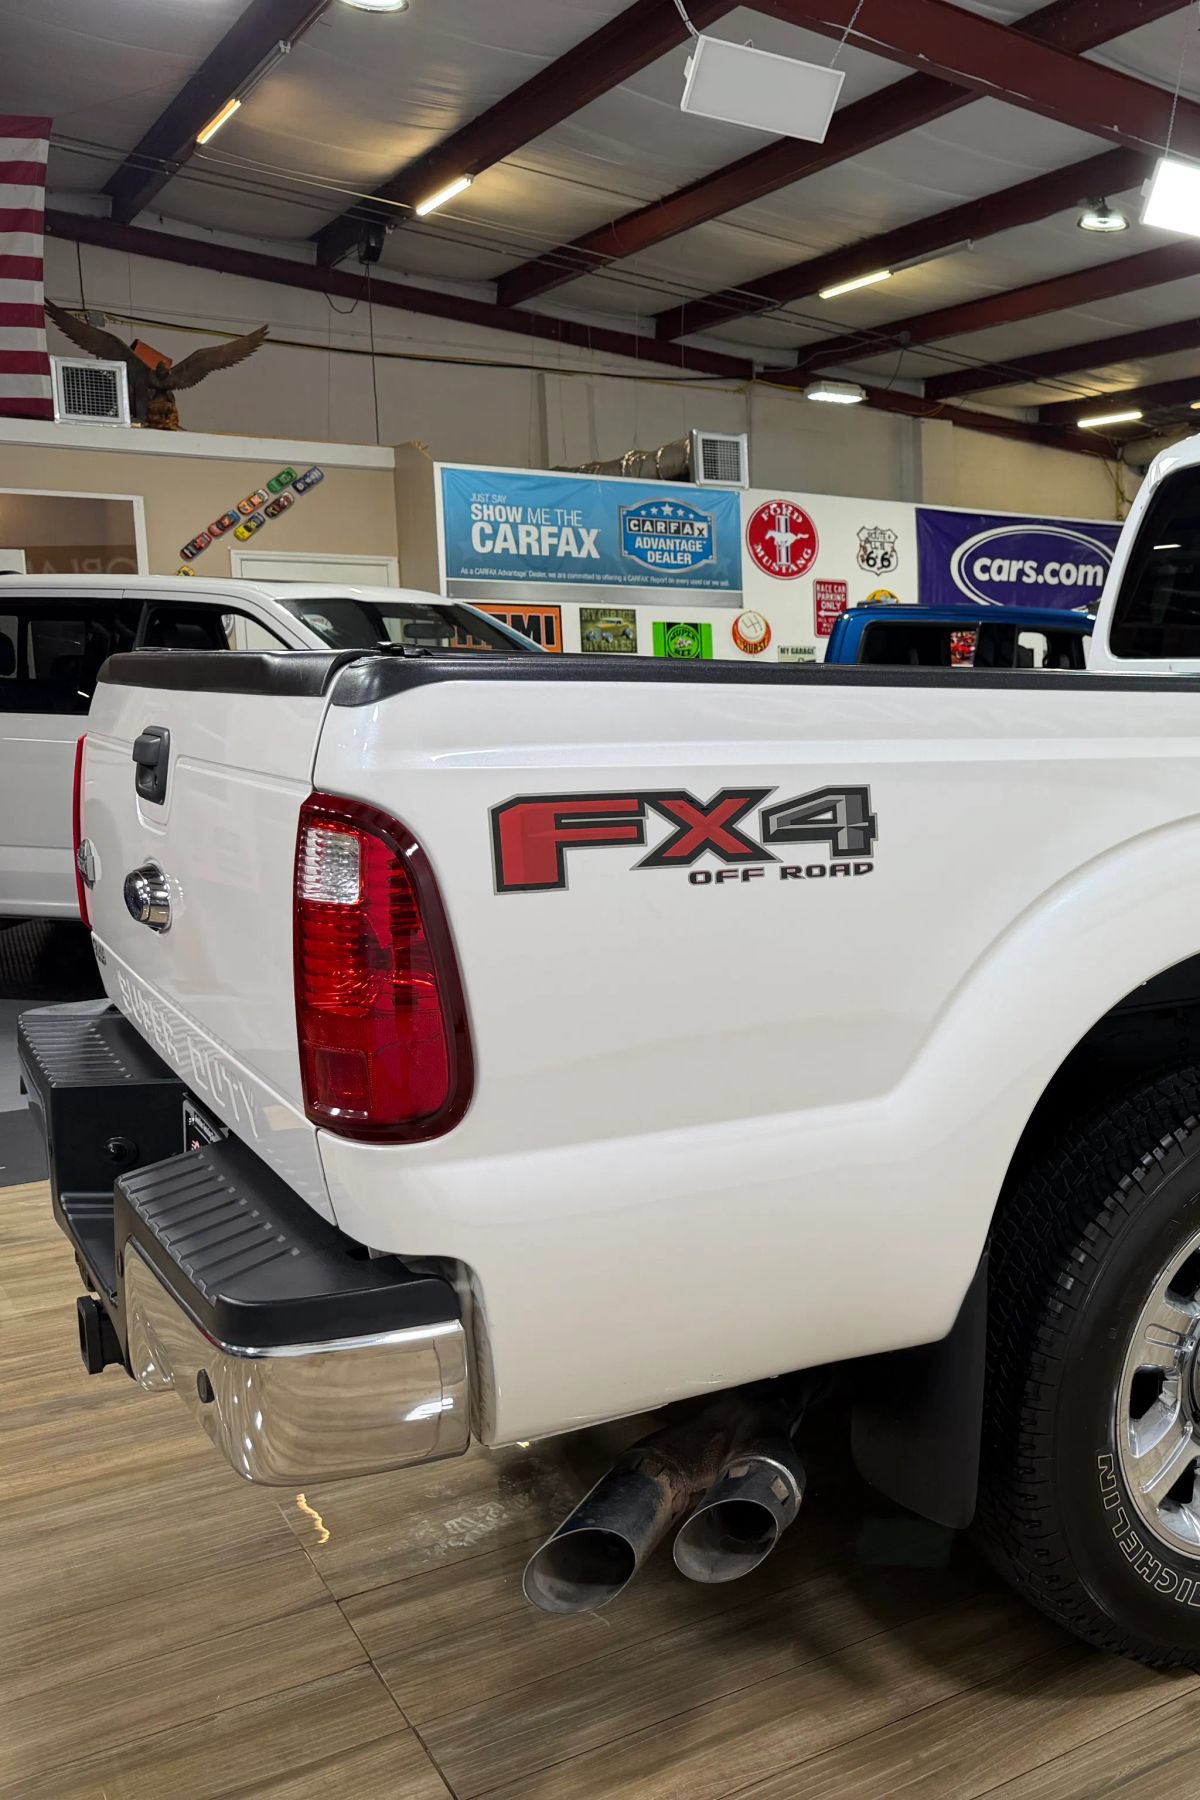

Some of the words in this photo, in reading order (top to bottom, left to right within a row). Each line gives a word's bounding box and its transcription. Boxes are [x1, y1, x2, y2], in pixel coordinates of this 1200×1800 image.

[470, 493, 489, 503] JUST
[492, 494, 507, 504] SAY
[470, 503, 523, 523] SHOW
[527, 507, 552, 525] ME
[554, 508, 583, 527] THE
[761, 504, 803, 523] FORD
[629, 519, 705, 537] CARFAX
[471, 521, 600, 559] CARFAX
[634, 536, 703, 552] ADVANTAGE
[647, 550, 692, 565] DEALER
[754, 542, 812, 574] MUSTANG
[866, 550, 891, 569] 66
[972, 556, 1104, 587] cars.com
[816, 584, 832, 593] RACE
[817, 593, 846, 602] PARKING
[821, 601, 842, 610] ONLY
[742, 642, 768, 654] HURST
[487, 784, 878, 896] FX4
[688, 866, 766, 886] OFF
[779, 862, 874, 880] ROAD
